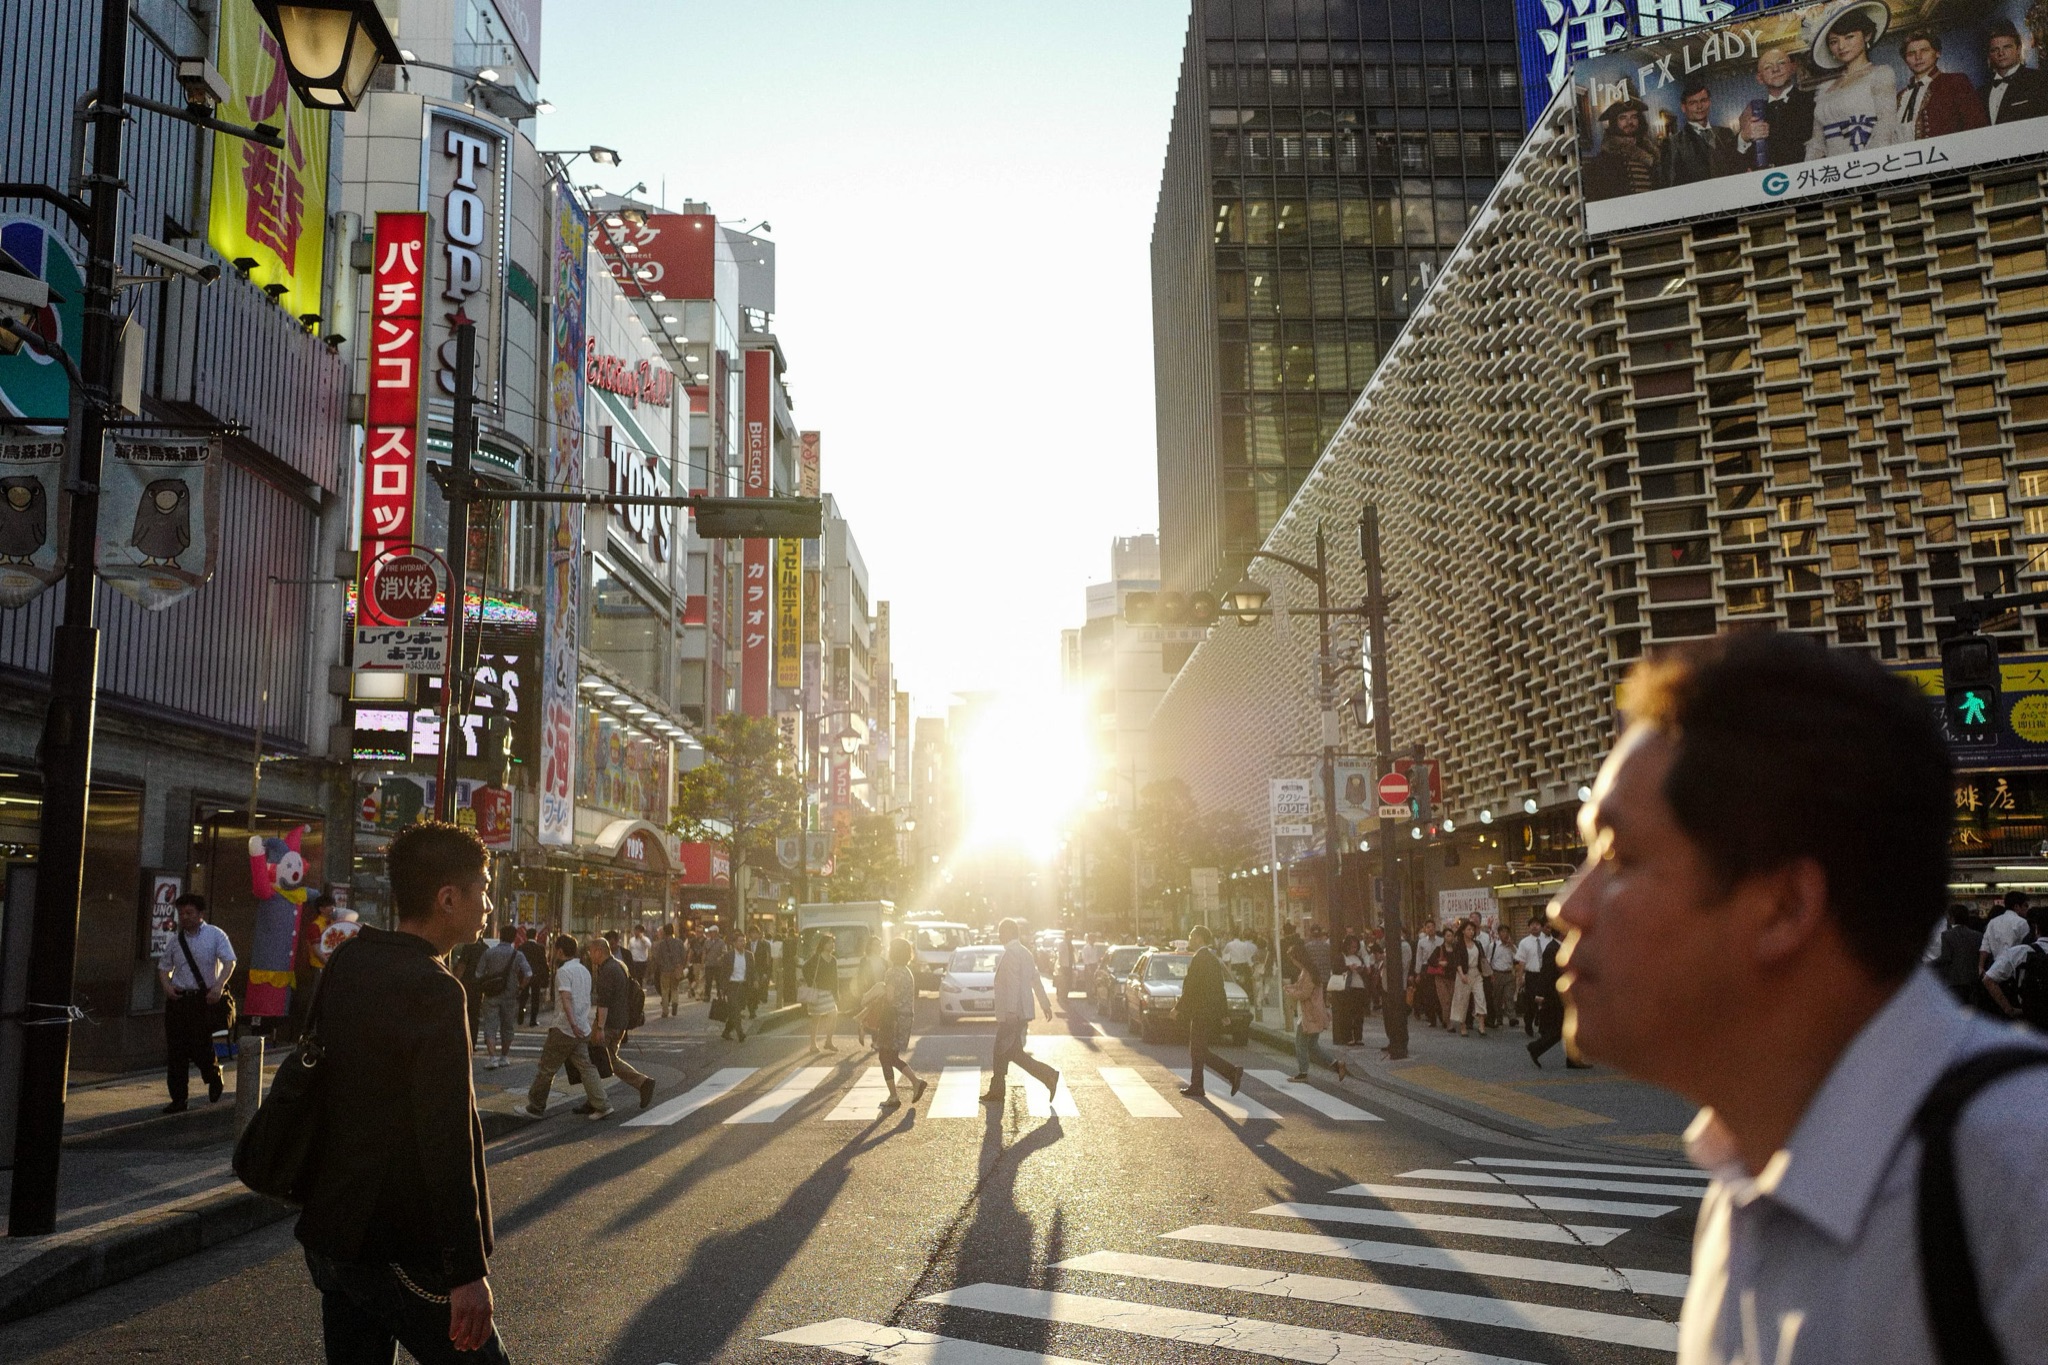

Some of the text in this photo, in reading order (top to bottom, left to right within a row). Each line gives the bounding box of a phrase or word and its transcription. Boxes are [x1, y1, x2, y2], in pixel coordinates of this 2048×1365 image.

[1590, 29, 1763, 106] I'M FX LADY
[1796, 144, 1949, 190] 外為どっとコム
[609, 260, 665, 283] CHO
[371, 240, 421, 577] パチンコ スロット
[748, 422, 762, 489] BIG ECHO
[385, 563, 427, 572] FIRE HYDRANT
[380, 575, 433, 600] 消火栓
[746, 563, 765, 648] カラオケ
[359, 630, 442, 644] レインボー
[387, 646, 441, 660] ホテル
